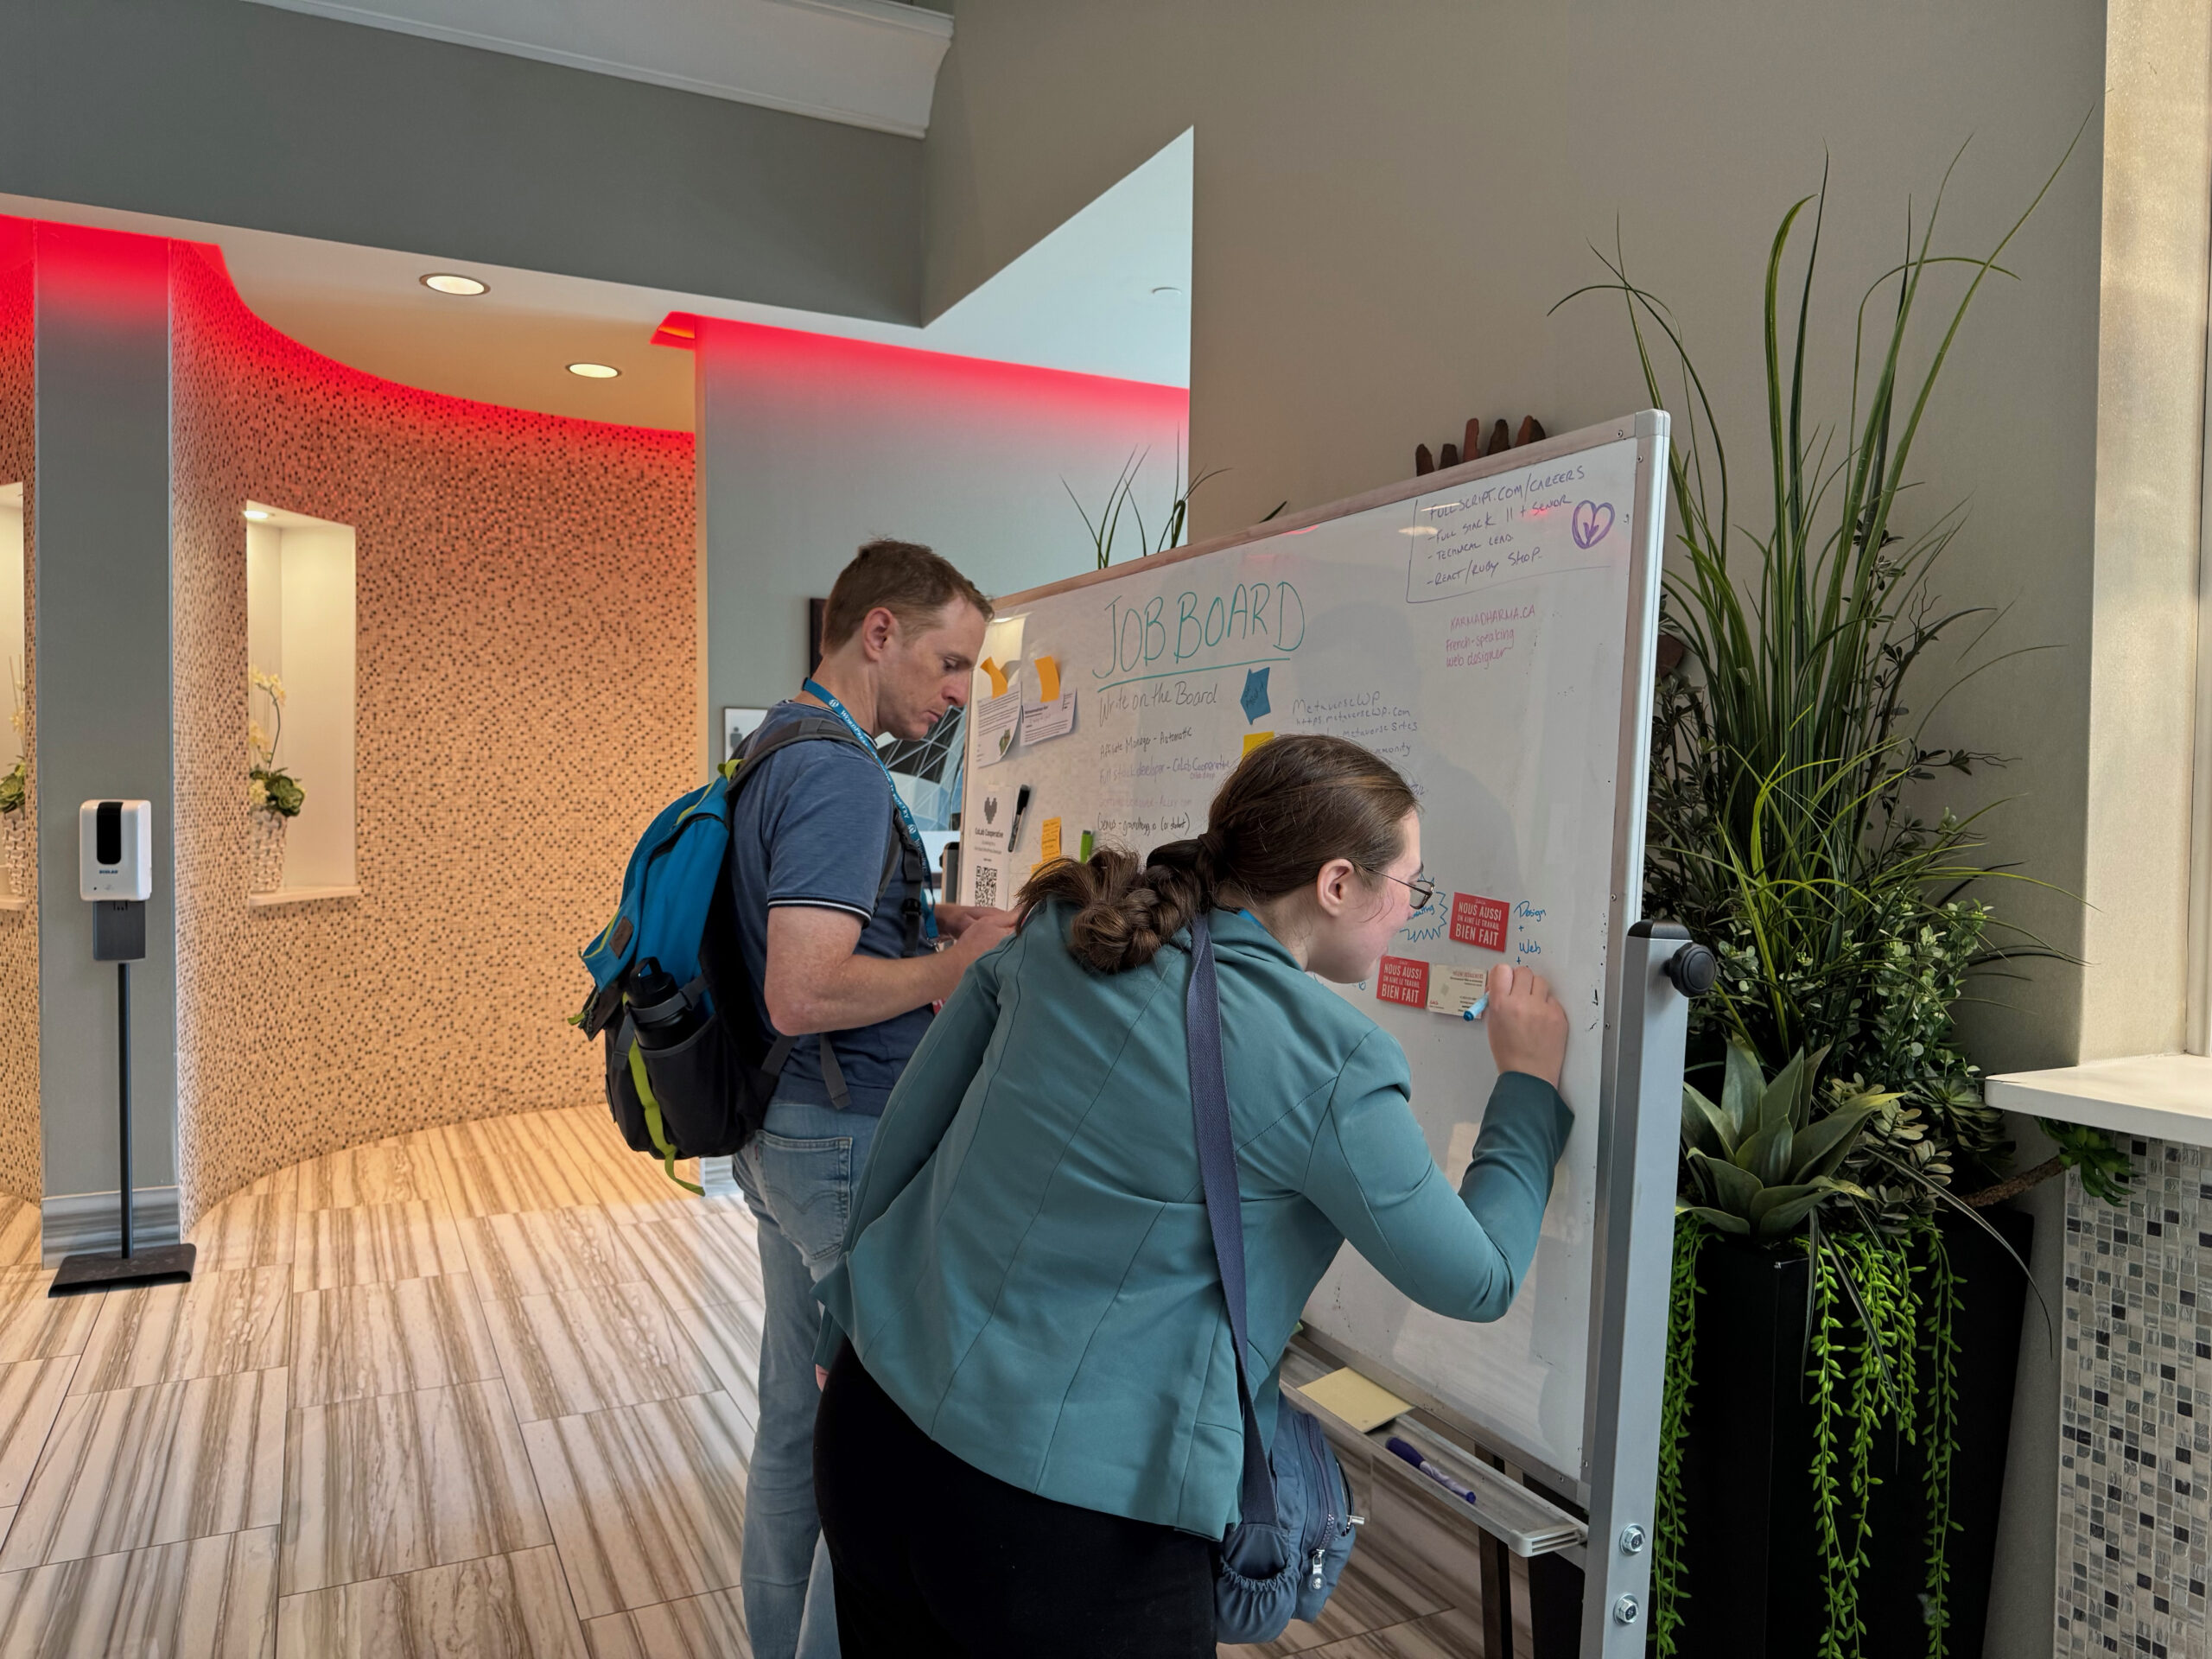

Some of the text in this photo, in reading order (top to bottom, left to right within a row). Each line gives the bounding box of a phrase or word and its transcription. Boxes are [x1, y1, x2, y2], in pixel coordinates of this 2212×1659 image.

[1091, 581, 1306, 679] JOB BOARD
[1132, 694, 1149, 710] on
[1151, 682, 1172, 703] the
[1458, 901, 1502, 921] NOUS AUSSI
[1464, 915, 1474, 925] AIME
[1475, 918, 1480, 926] LE
[1481, 919, 1500, 931] TRAVAIL
[1455, 923, 1499, 947] BIEN FAIT
[1519, 938, 1541, 955] Web
[1383, 963, 1422, 980] NOUS AUSSI
[1381, 983, 1400, 1000] BIEN
[1402, 988, 1420, 1003] FAIT
